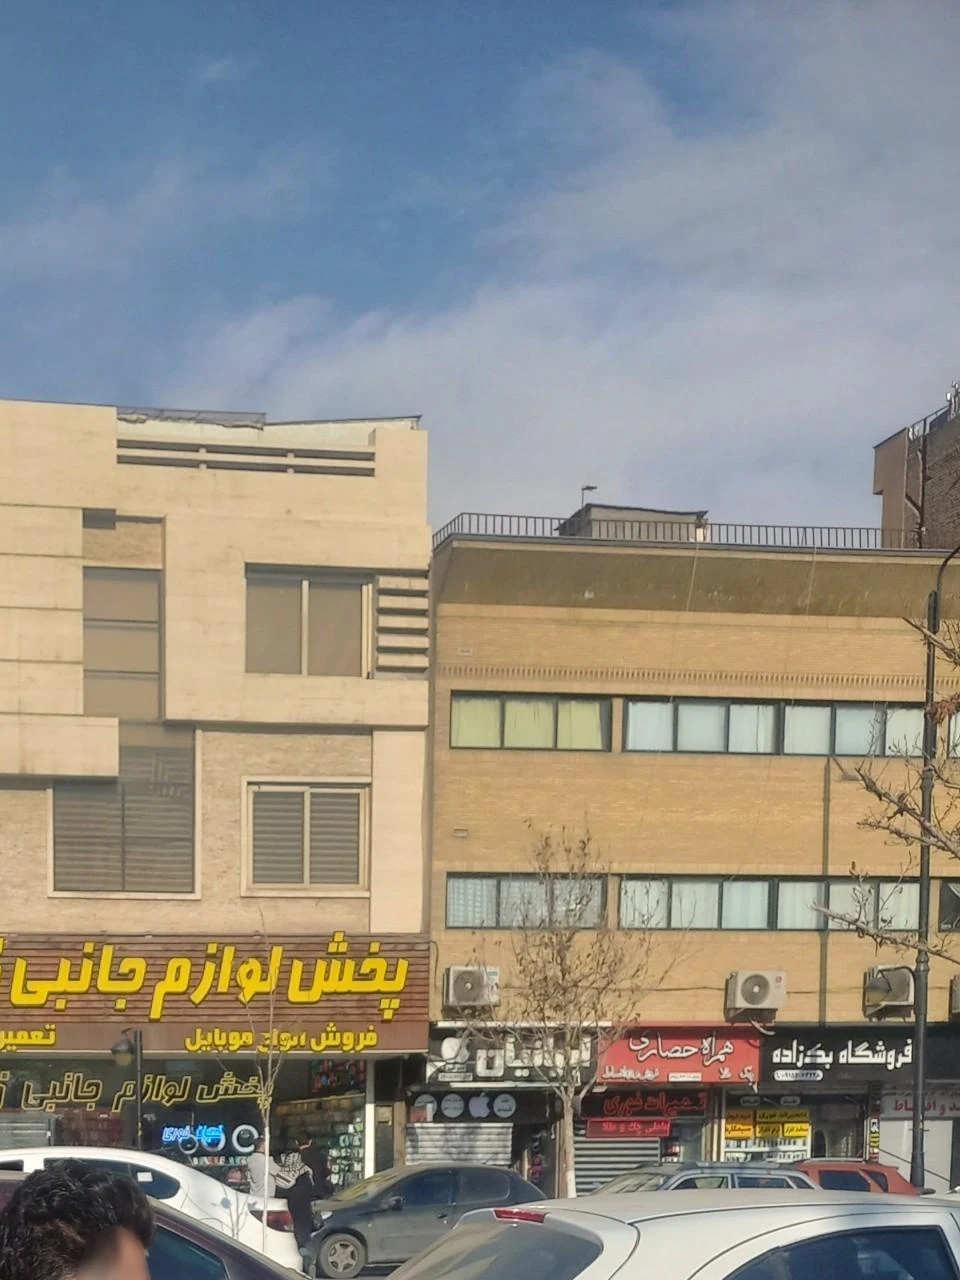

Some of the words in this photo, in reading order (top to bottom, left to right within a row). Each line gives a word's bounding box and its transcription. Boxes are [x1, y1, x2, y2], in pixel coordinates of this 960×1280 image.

[8, 941, 148, 1012] جانبی
[149, 940, 285, 1020] لوازم
[286, 931, 410, 1021] پخش
[184, 1025, 255, 1053] موبایل
[310, 1022, 379, 1053] فروش
[628, 1031, 700, 1063] حصاری
[701, 1031, 736, 1067] همراه
[838, 1038, 914, 1071] فروشگاه
[21, 1072, 103, 1113] جانبی
